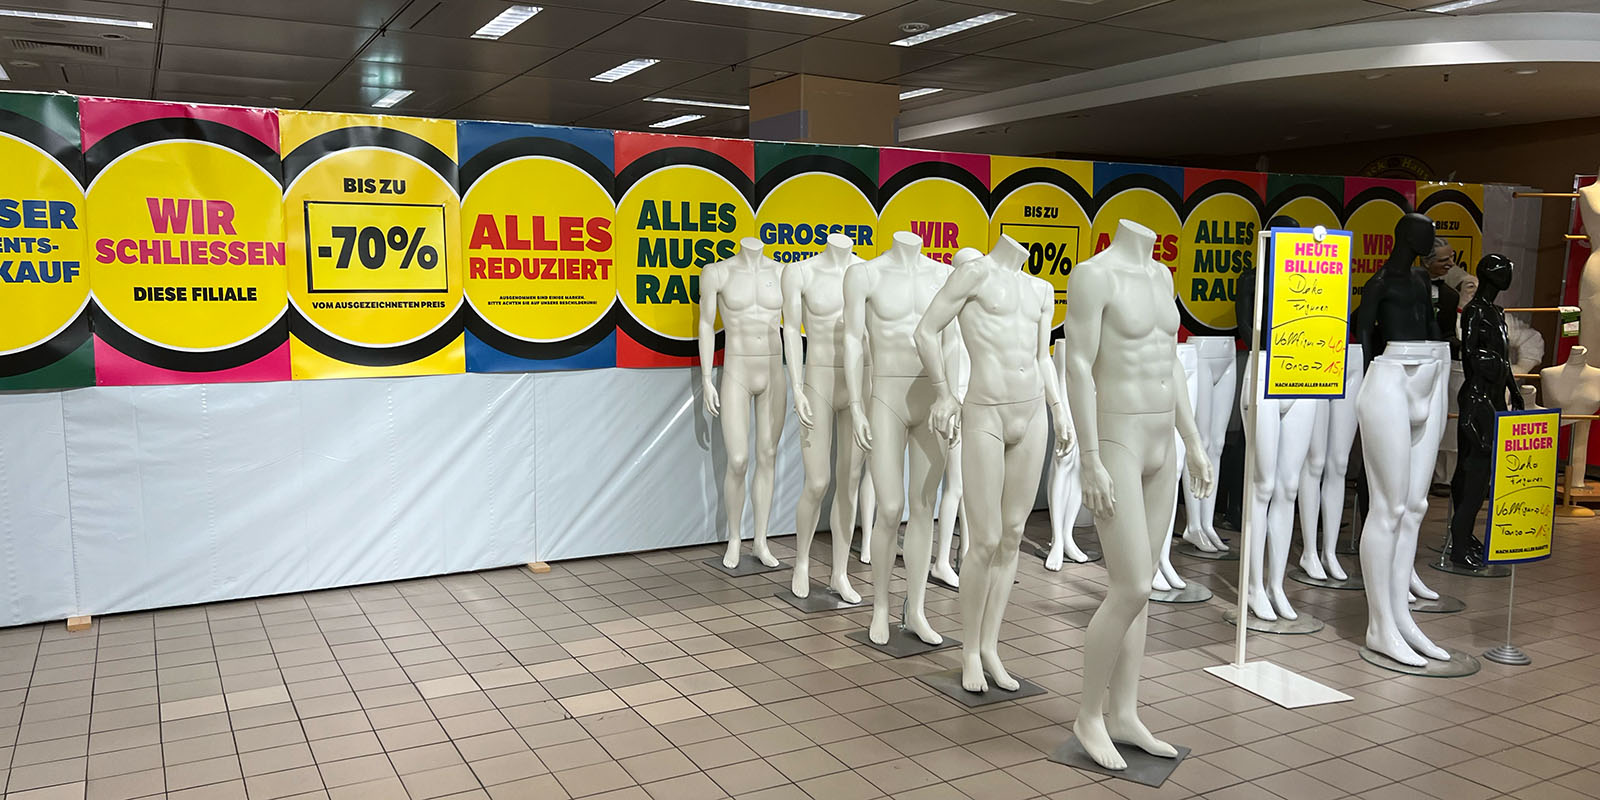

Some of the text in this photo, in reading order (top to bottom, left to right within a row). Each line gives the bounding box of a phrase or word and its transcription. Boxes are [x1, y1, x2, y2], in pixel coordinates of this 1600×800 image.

[343, 177, 406, 195] BIS ZU
[146, 197, 237, 235] WIR
[636, 199, 737, 233] ALLES
[1024, 206, 1059, 219] BIS ZU
[469, 214, 613, 252] ALLES
[911, 221, 960, 249] WIR
[1194, 220, 1255, 245] ALLES
[1449, 221, 1460, 230] ZU
[95, 238, 286, 266] SCHLIESSEN
[318, 226, 438, 270] -70%
[637, 237, 737, 270] MUSS
[1294, 242, 1339, 258] HEUTE
[469, 257, 613, 281] REDUZIERT
[1193, 249, 1253, 273] MUSS
[1284, 259, 1344, 276] BILLIGER
[133, 286, 257, 302] DIESE FILIALE
[1289, 273, 1323, 295] Deko
[312, 301, 446, 310] VOM AUSGEZEICHNETEN PREIS
[1512, 422, 1548, 436] HEUTE
[1504, 436, 1553, 452] BILLIGER
